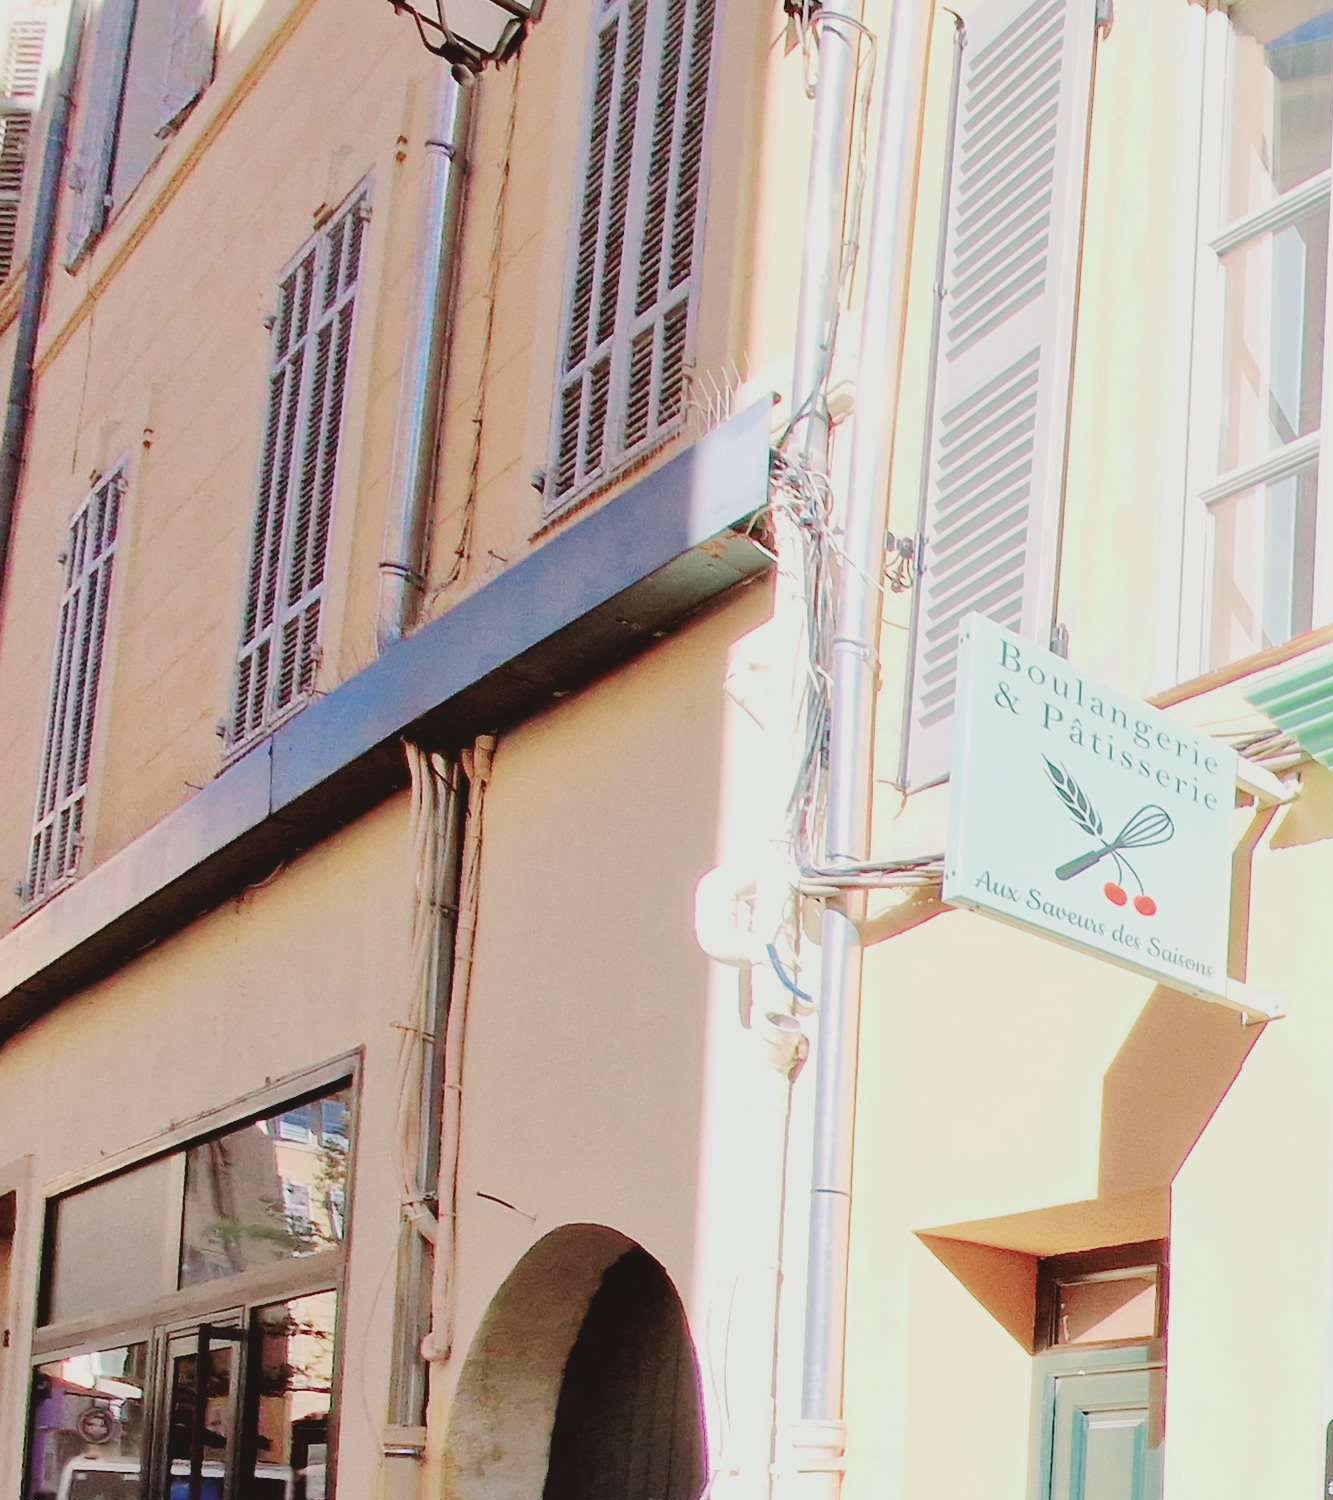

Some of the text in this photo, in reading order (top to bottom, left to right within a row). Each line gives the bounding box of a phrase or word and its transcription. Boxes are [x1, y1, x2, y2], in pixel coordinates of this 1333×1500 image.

[994, 681, 1218, 810] & Pâtisserie
[1000, 640, 1219, 775] Boulangerie
[975, 870, 1213, 978] Aux Saveurs des Saisons
